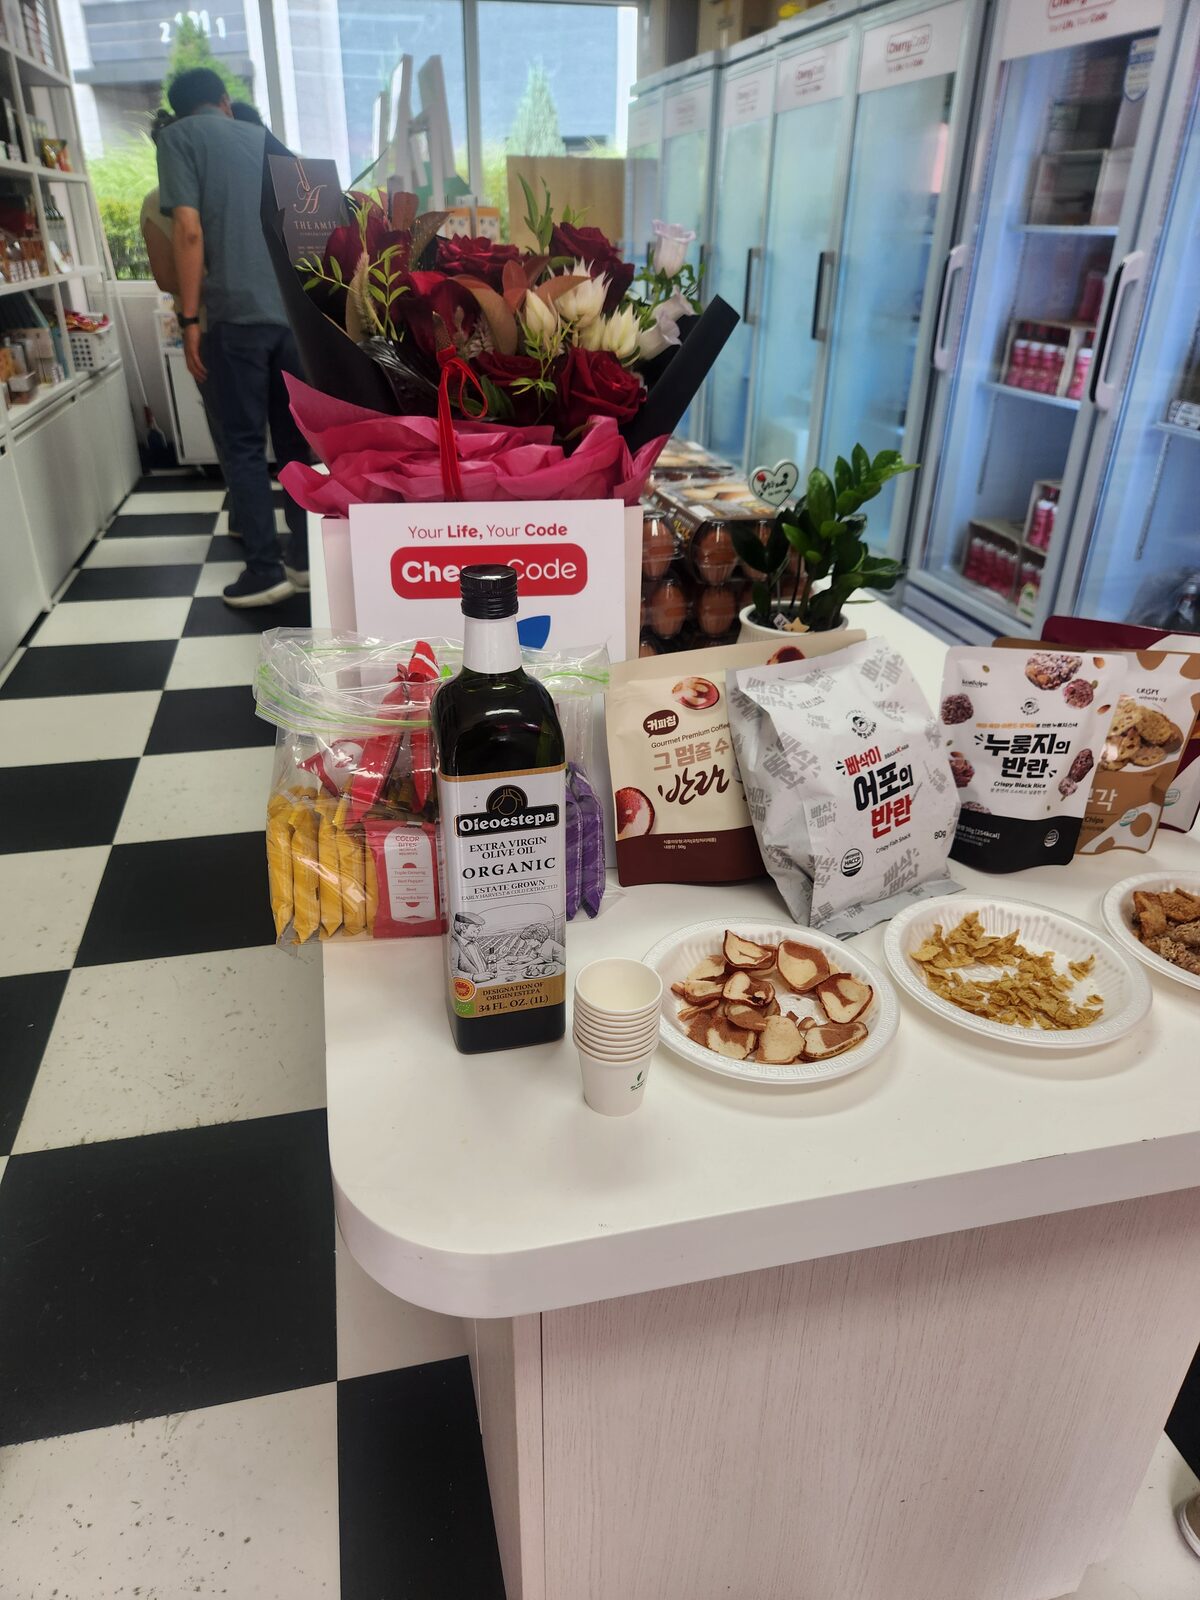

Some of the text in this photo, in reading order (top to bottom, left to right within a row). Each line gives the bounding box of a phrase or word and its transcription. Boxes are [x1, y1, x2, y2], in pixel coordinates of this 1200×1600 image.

[408, 523, 568, 540] Your Life, Your Code
[647, 715, 677, 731] 커피칩
[651, 736, 681, 749] Gourmet
[681, 728, 711, 742] Premium
[984, 733, 1071, 757] 누룽지의
[653, 737, 730, 771] 그 멈출 수
[844, 746, 882, 776] 빠삭이
[1001, 757, 1050, 779] 반란
[853, 761, 914, 812] 어포의
[459, 812, 556, 832] Oleoestepa
[871, 794, 913, 839] 반란
[1084, 815, 1105, 824] Chips
[934, 830, 947, 840] 80g
[469, 836, 548, 853] EXTRA VIRGIN
[481, 846, 536, 860] OLIVE OIL
[875, 844, 889, 854] Crispy
[462, 857, 557, 880] ORGANIC
[844, 856, 861, 866] HACCP
[474, 879, 546, 895] ESTATE GROWN
[480, 890, 505, 899] HARVEST
[525, 884, 559, 894] EXTRACTED
[482, 981, 545, 996] DESIGNATION OF
[486, 989, 541, 1001] ORIGIN ESTEPA
[478, 994, 549, 1014] 34 FL. OZ. (1L)
